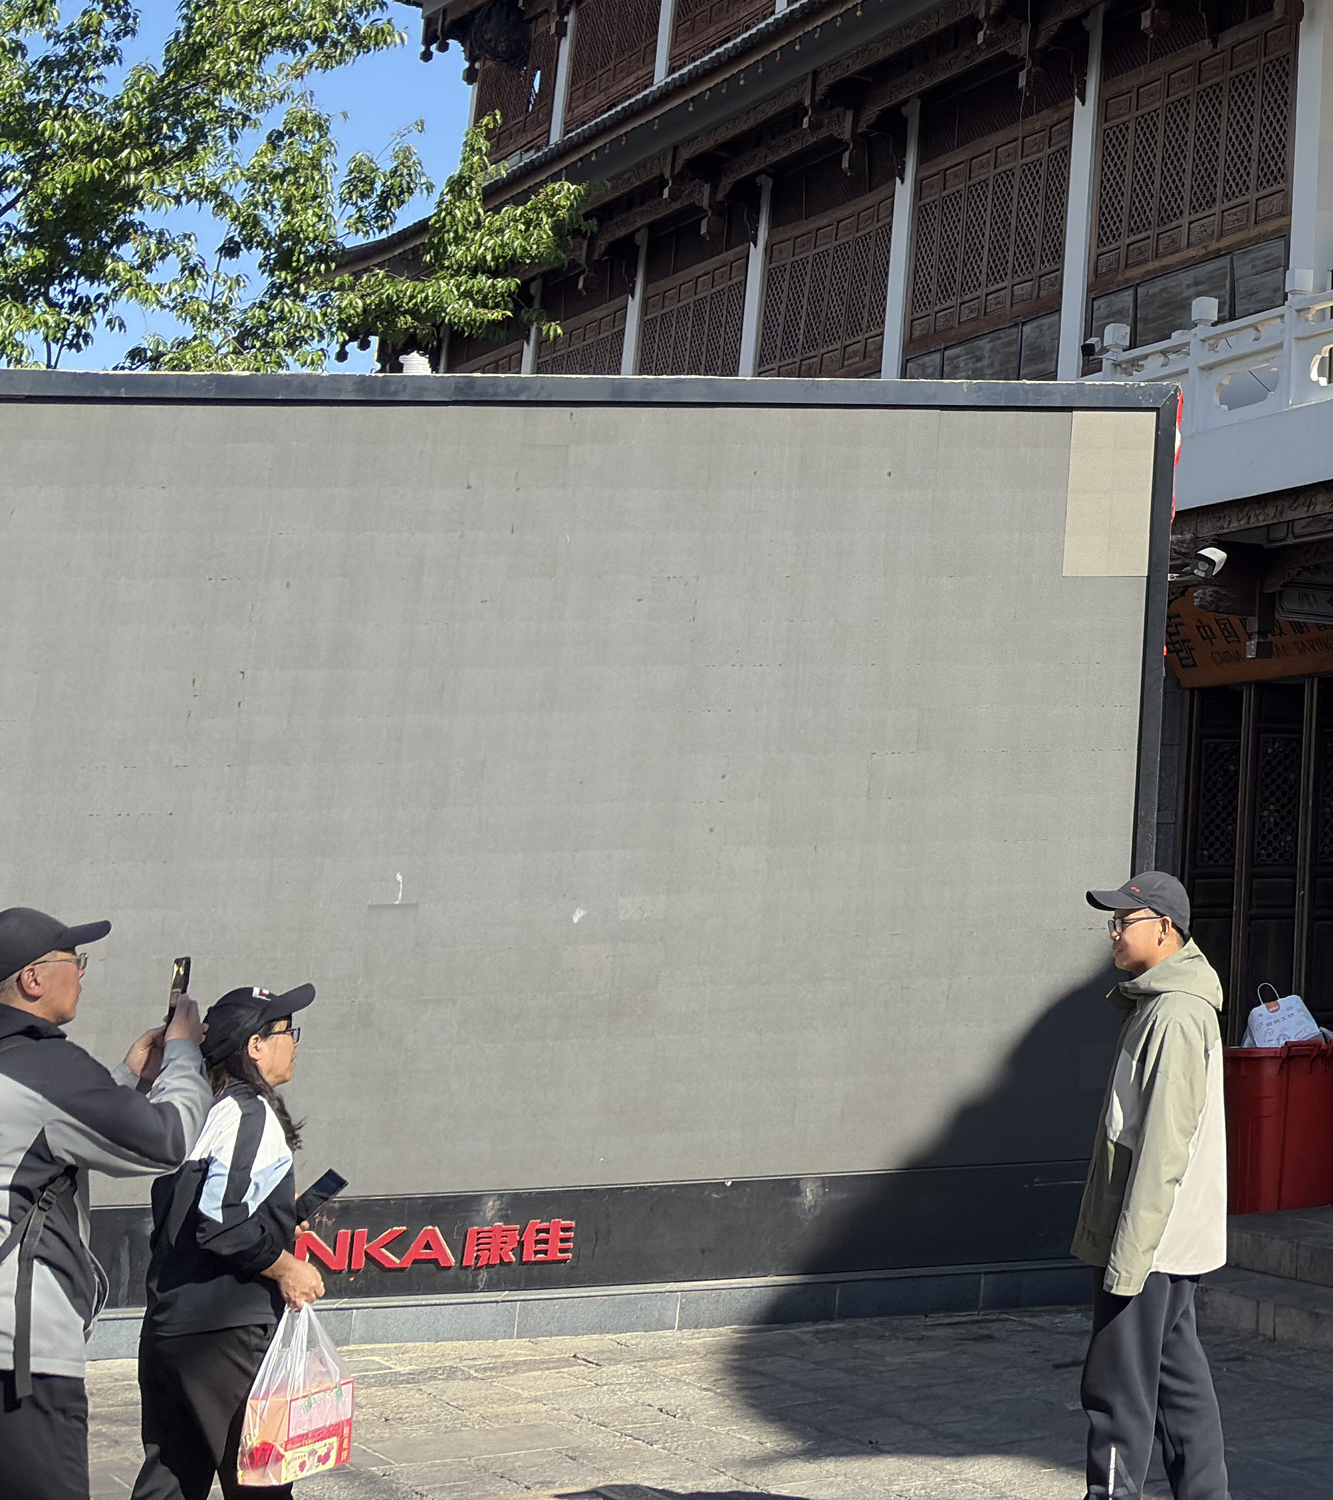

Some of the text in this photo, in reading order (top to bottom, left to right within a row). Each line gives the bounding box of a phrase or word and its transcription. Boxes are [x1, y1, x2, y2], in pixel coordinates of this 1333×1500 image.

[1210, 649, 1245, 666] CHINA
[294, 1218, 576, 1271] NKA 康佳
